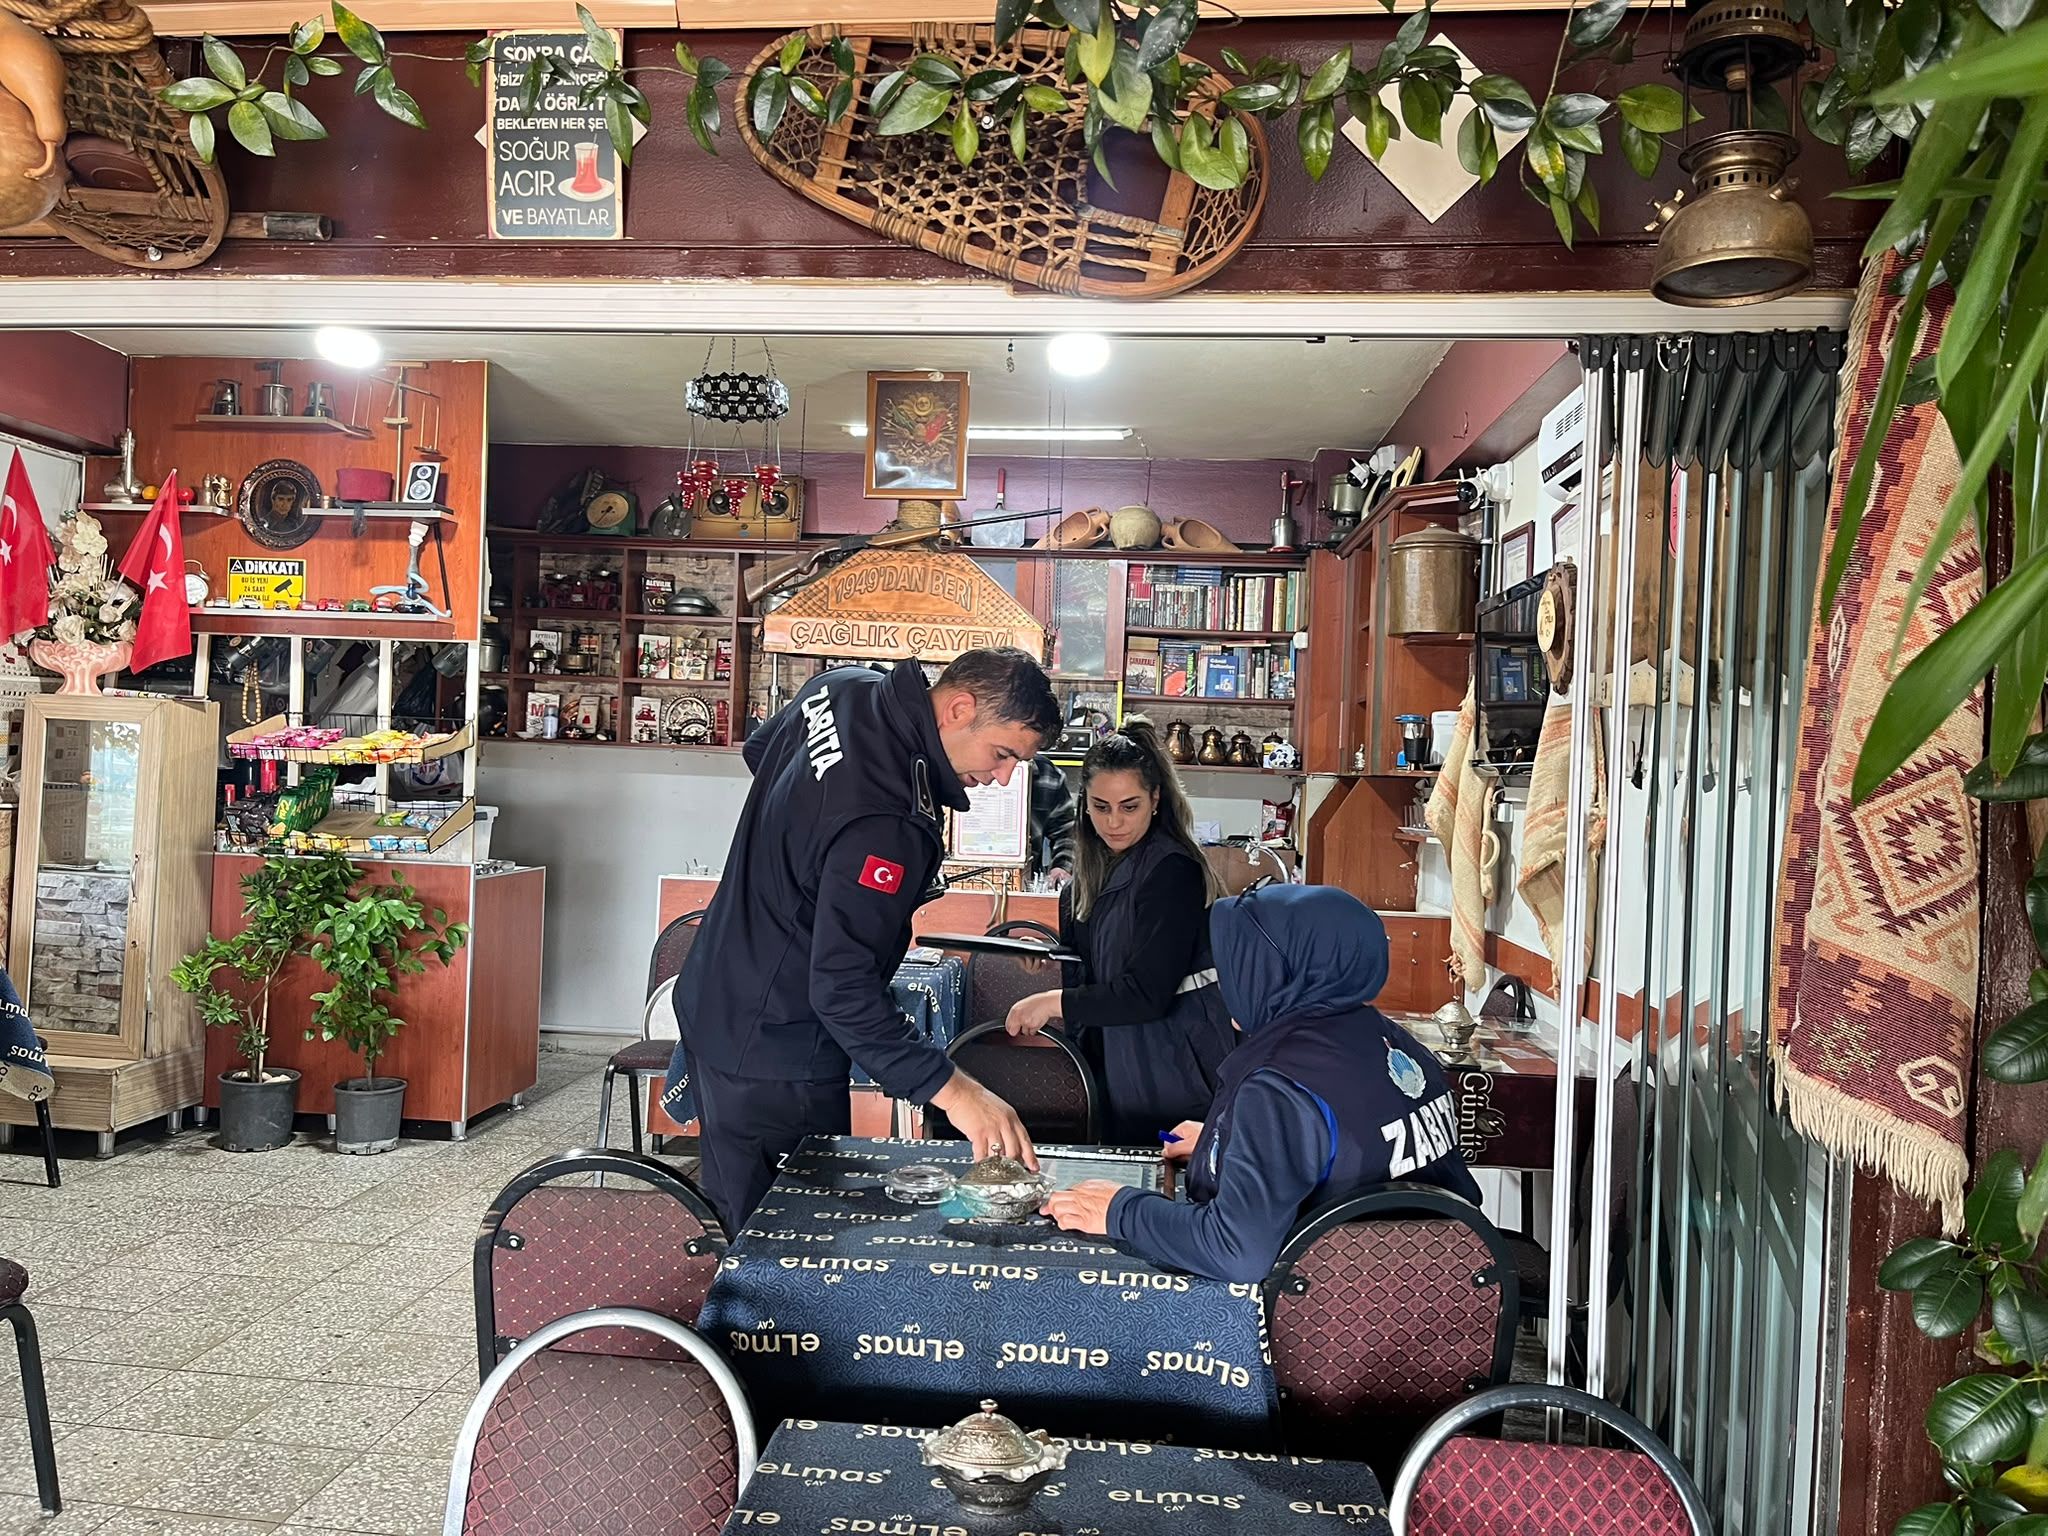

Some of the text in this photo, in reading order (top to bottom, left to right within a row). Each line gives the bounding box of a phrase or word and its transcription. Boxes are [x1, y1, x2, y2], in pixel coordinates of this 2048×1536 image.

[569, 46, 597, 67] ÇA
[498, 96, 541, 112] DA
[497, 117, 560, 130] BEKLEYEN
[561, 118, 585, 130] HER
[499, 136, 570, 161] SOĞUR
[499, 170, 556, 197] ACIR
[502, 208, 610, 225] VE BAYATLAR
[245, 560, 299, 575] DİKKAT!
[834, 564, 974, 613] 1949'DAN BERİ
[790, 620, 1015, 655] ÇAĞLIK ÇAYEVİ
[801, 684, 844, 782] ZABITA
[1098, 1147, 1162, 1155] eLm
[742, 1229, 835, 1242] eLma
[824, 1274, 843, 1285] ÇAY
[972, 1280, 991, 1292] ÇAY
[1121, 1290, 1141, 1302] ÇAY
[1288, 1501, 1389, 1520] eLm
